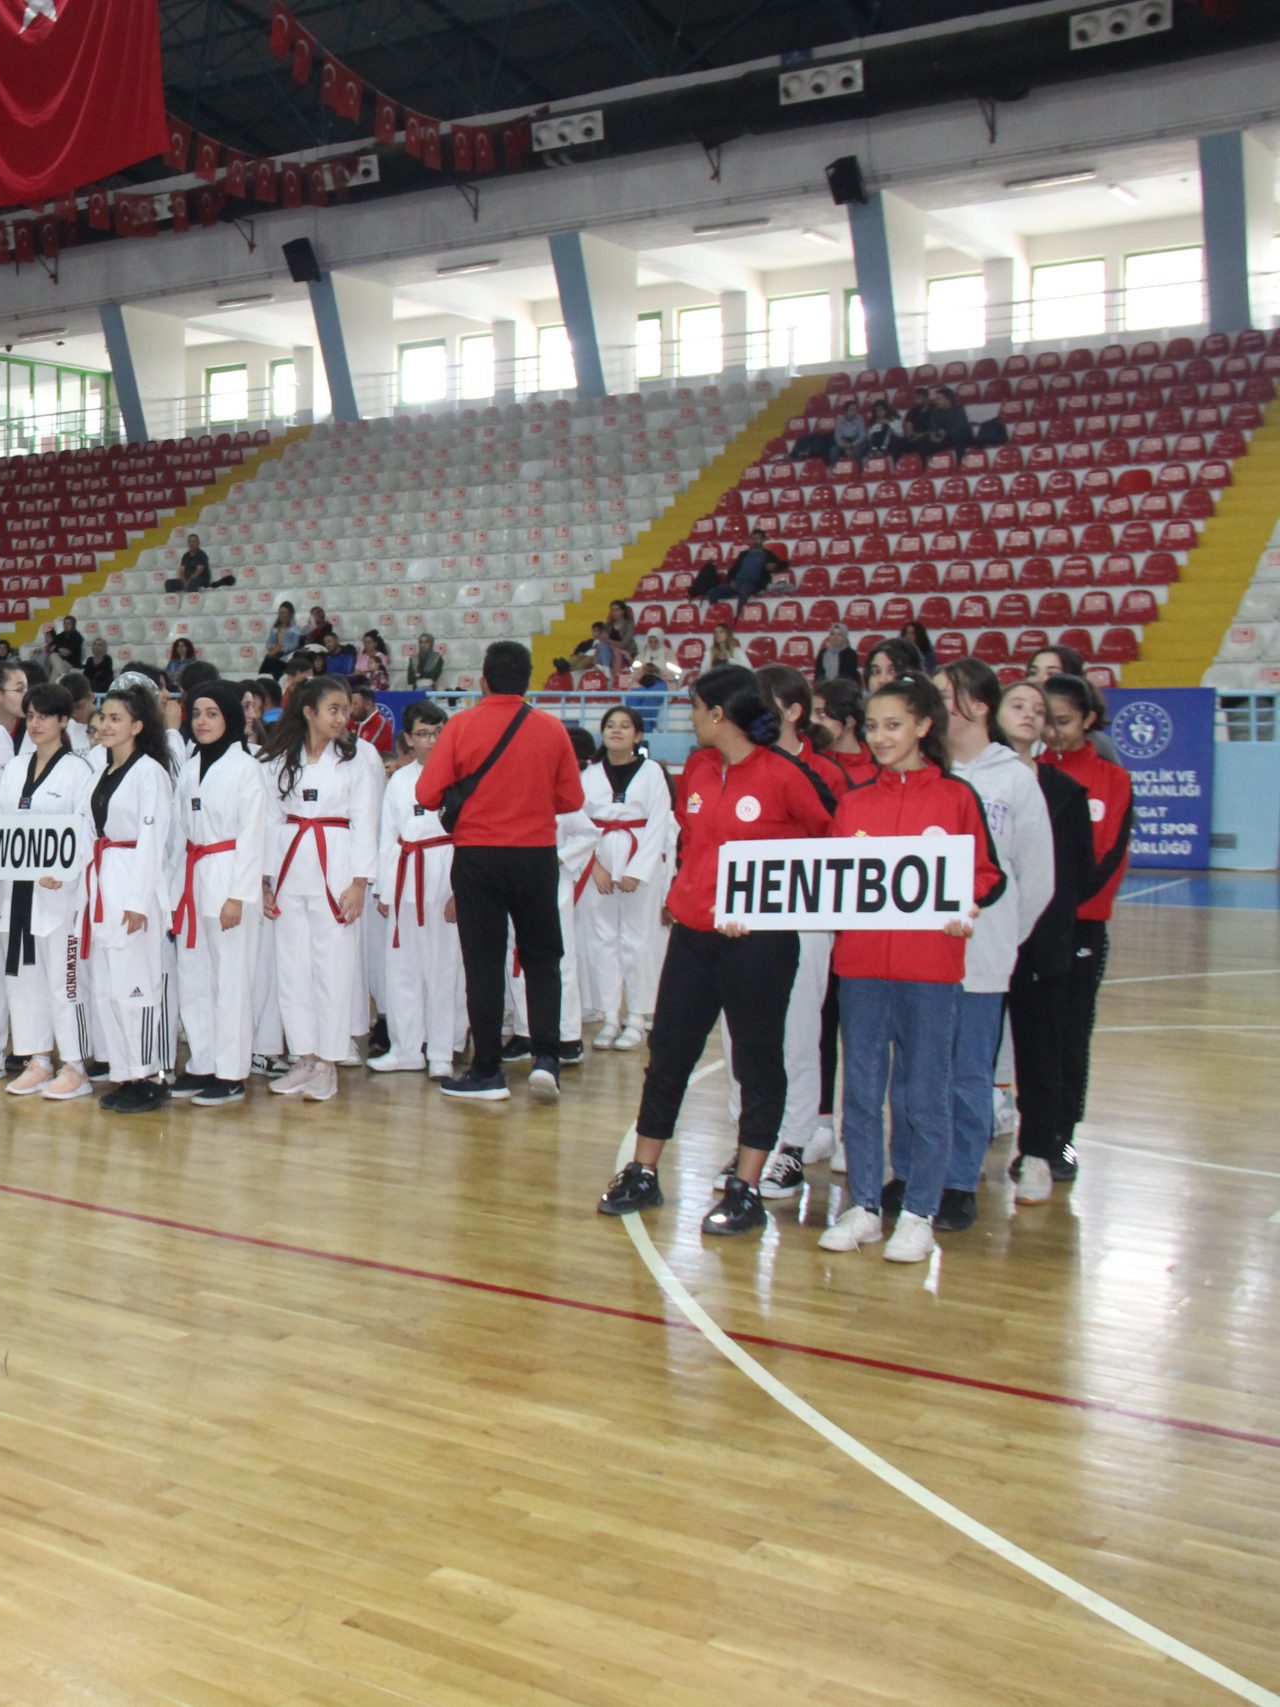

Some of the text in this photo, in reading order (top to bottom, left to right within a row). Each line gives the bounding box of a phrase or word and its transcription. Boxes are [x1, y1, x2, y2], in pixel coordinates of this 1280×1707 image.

[1176, 770, 1197, 782] VE
[1139, 822, 1199, 835] VE SPOR
[725, 854, 961, 914] HENTBOL
